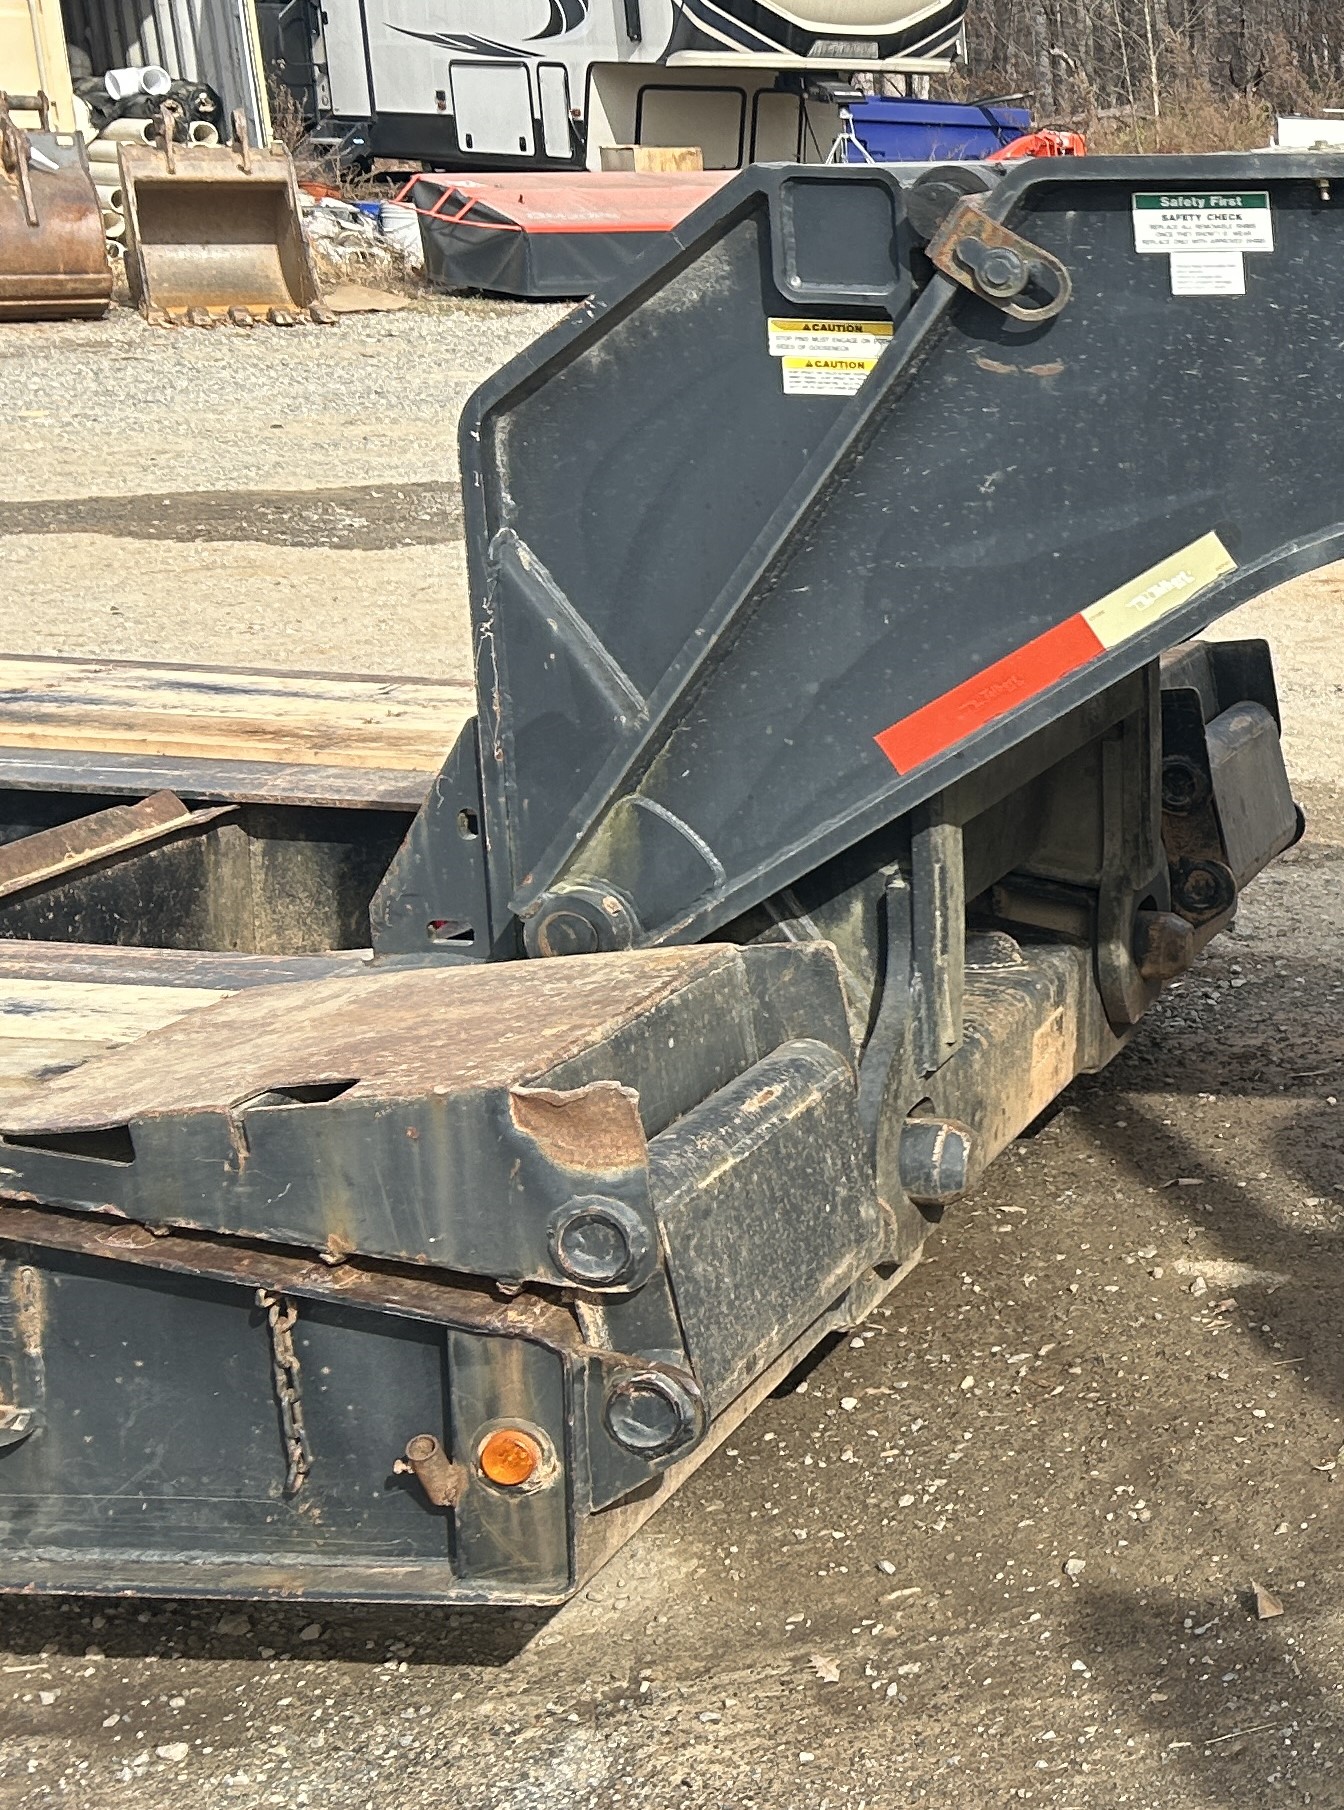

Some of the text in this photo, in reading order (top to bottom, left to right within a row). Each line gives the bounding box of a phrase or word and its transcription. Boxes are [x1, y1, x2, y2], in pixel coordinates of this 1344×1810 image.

[1159, 195, 1242, 208] Safety First
[1161, 213, 1201, 221] SAFETY
[811, 323, 863, 333] CAUTION
[814, 360, 865, 369] CAUTION
